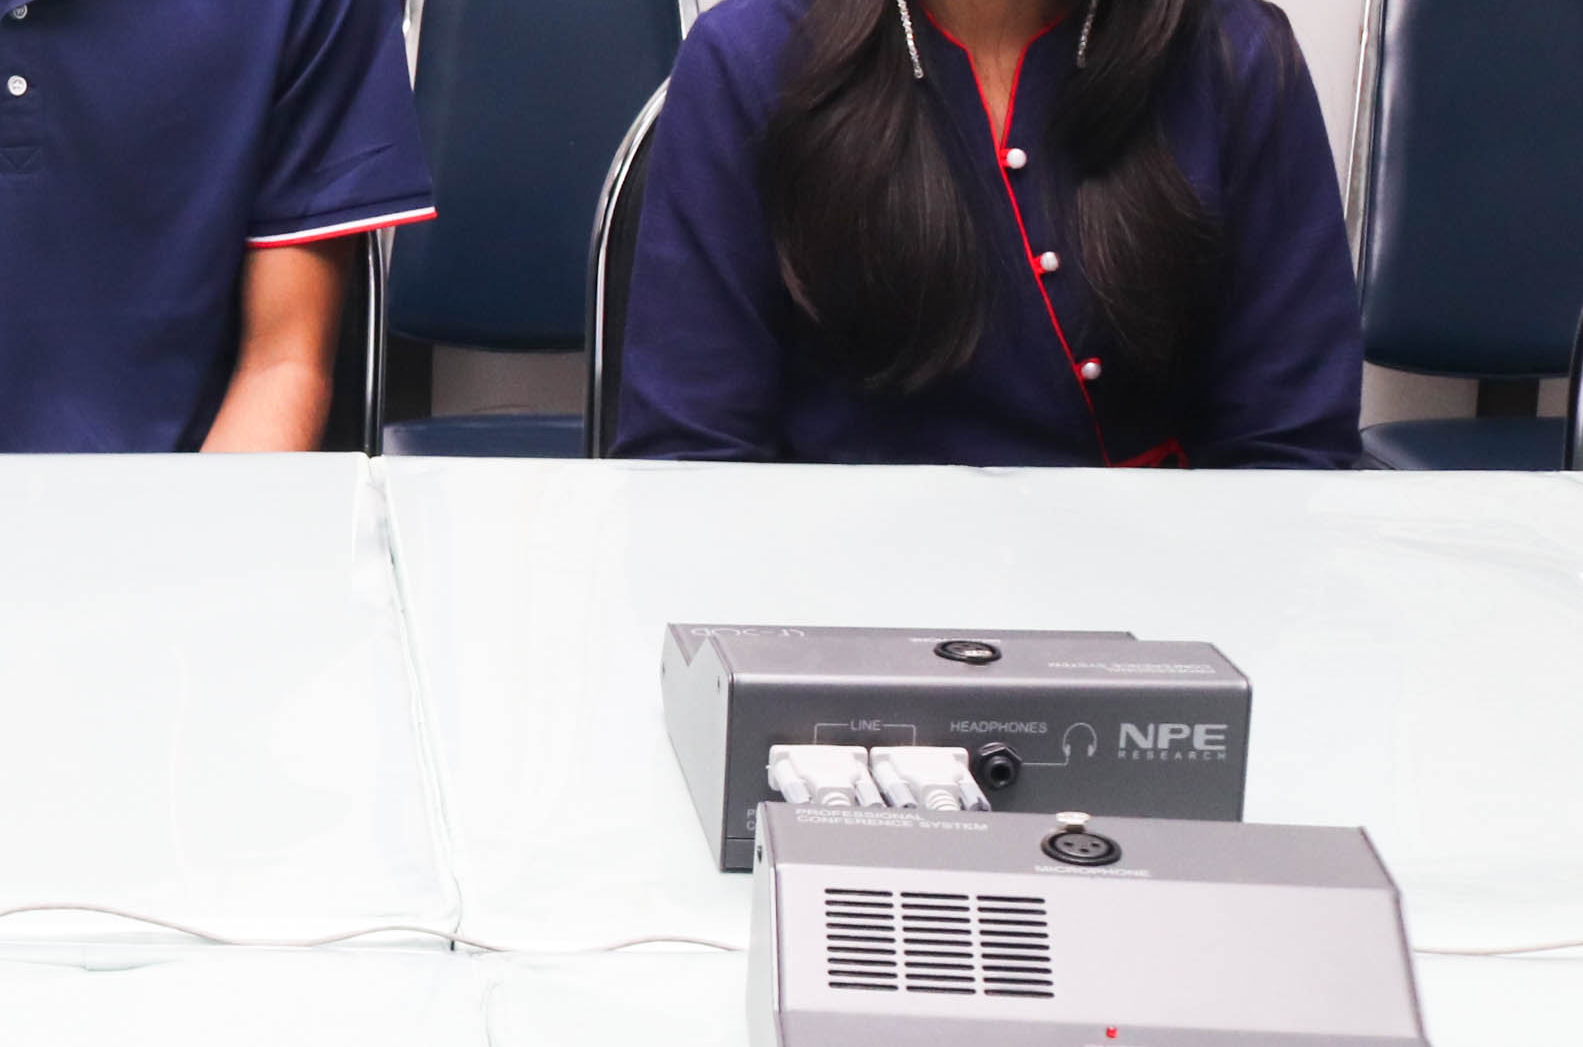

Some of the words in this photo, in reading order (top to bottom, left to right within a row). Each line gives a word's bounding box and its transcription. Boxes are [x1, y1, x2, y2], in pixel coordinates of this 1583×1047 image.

[850, 720, 882, 731] LINE
[950, 721, 1048, 734] HEADPHONES
[1119, 723, 1228, 750] NPE
[1118, 750, 1227, 760] RESEARCH
[795, 808, 926, 821] PROFESSIONAL
[796, 816, 915, 828] CONFERENCE
[918, 820, 989, 832] SYSTEM
[1033, 865, 1152, 878] MICROPHONE
